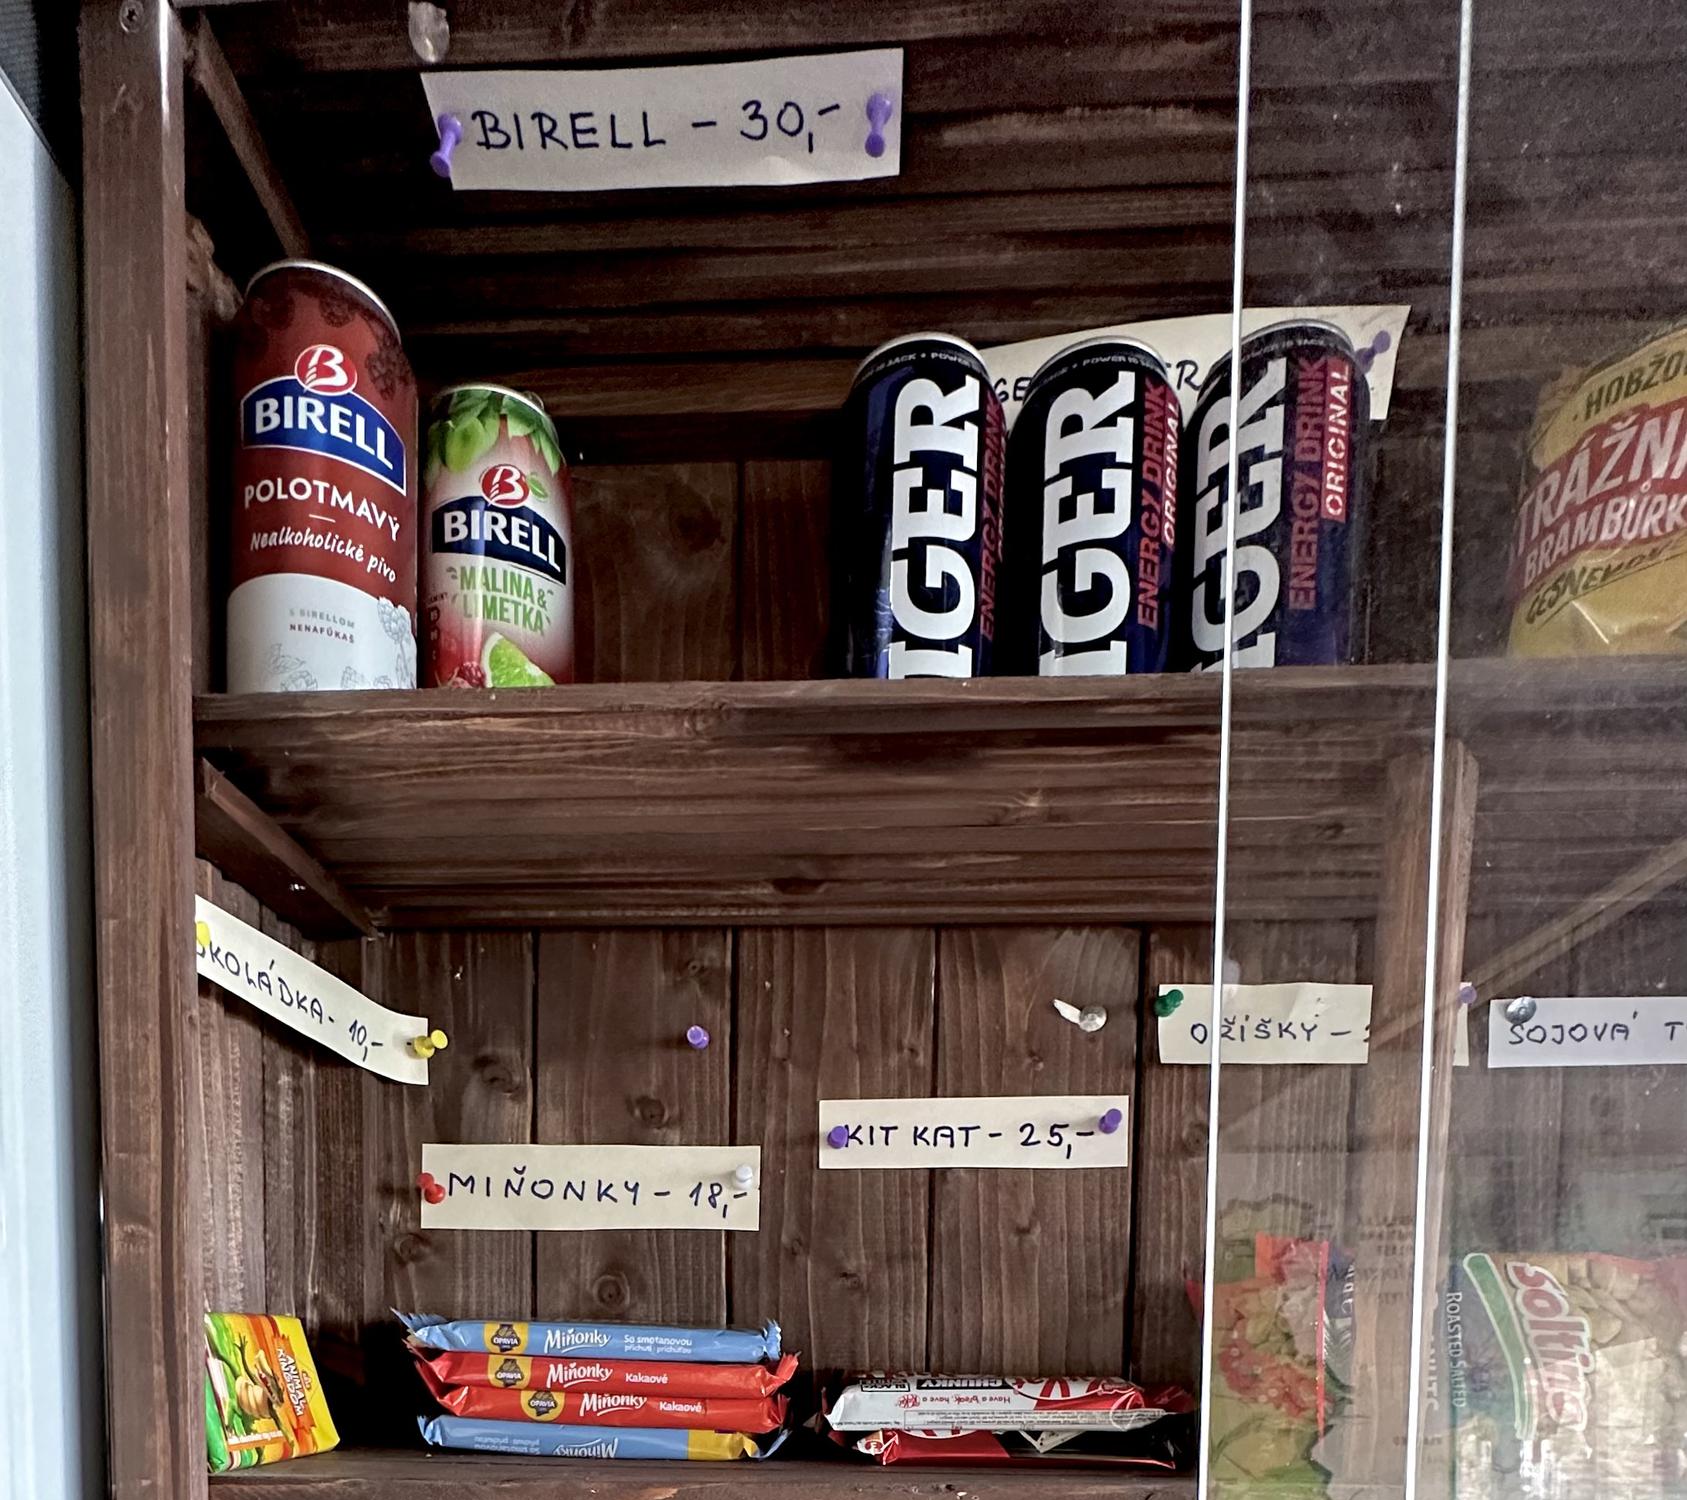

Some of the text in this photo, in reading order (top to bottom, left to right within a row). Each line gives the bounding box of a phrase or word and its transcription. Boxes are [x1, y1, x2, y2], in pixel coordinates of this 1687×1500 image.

[472, 110, 666, 150] BIRELL
[255, 395, 394, 470] BIRELL
[1141, 376, 1167, 481] DRINK
[1325, 365, 1350, 517] ORIGINAL
[1164, 404, 1181, 548] ORIGINAL
[1288, 356, 1326, 610] ENERGY DRINK
[244, 477, 401, 542] POLOTMAVÝ
[888, 375, 980, 679] IGER
[979, 390, 1003, 643] ENERGY DRINK
[1039, 371, 1136, 676] IGER
[1191, 357, 1287, 672] IGER
[250, 527, 397, 583] Nealkoholické pivo
[443, 509, 561, 572] BIRELL
[1138, 487, 1163, 631] ENERGY
[459, 565, 534, 605] MALINA
[1509, 1010, 1639, 1047] SOJOVÁ
[845, 1124, 898, 1147] KIT
[913, 1125, 981, 1148] KAT
[448, 1165, 640, 1206] MIŇONKY
[493, 1337, 520, 1347] OPAVIA
[545, 1328, 611, 1353] Miňonky
[547, 1363, 613, 1388] Miňonky
[625, 1372, 668, 1384] Kakaové
[530, 1400, 556, 1409] OPAVIA
[580, 1392, 647, 1417] Miňonky
[659, 1401, 702, 1413] Kakaové
